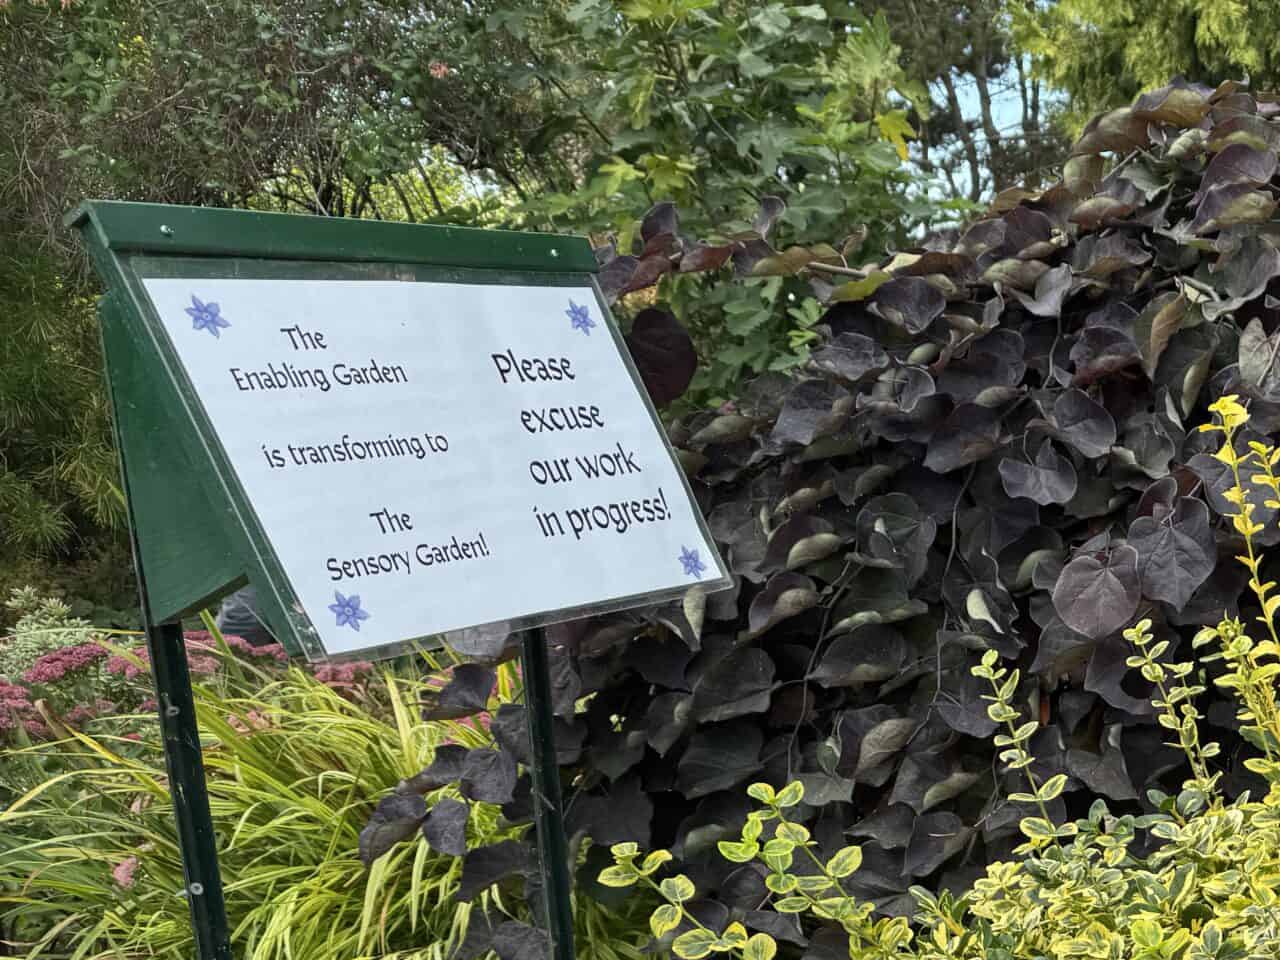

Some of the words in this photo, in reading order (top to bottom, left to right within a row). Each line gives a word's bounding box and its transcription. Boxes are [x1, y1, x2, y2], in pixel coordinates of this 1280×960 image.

[279, 324, 327, 350] The
[229, 362, 331, 393] Enabling
[332, 359, 409, 386] Garden
[491, 348, 576, 384] Please
[520, 405, 605, 434] excuse
[261, 445, 286, 469] is
[287, 434, 424, 466] transforming
[422, 433, 449, 458] to
[529, 458, 573, 485] our
[574, 442, 642, 479] work
[369, 507, 414, 534] The
[533, 505, 565, 537] in
[565, 487, 672, 539] progress!
[326, 551, 411, 581] Sensory
[415, 532, 490, 566] Garden!
